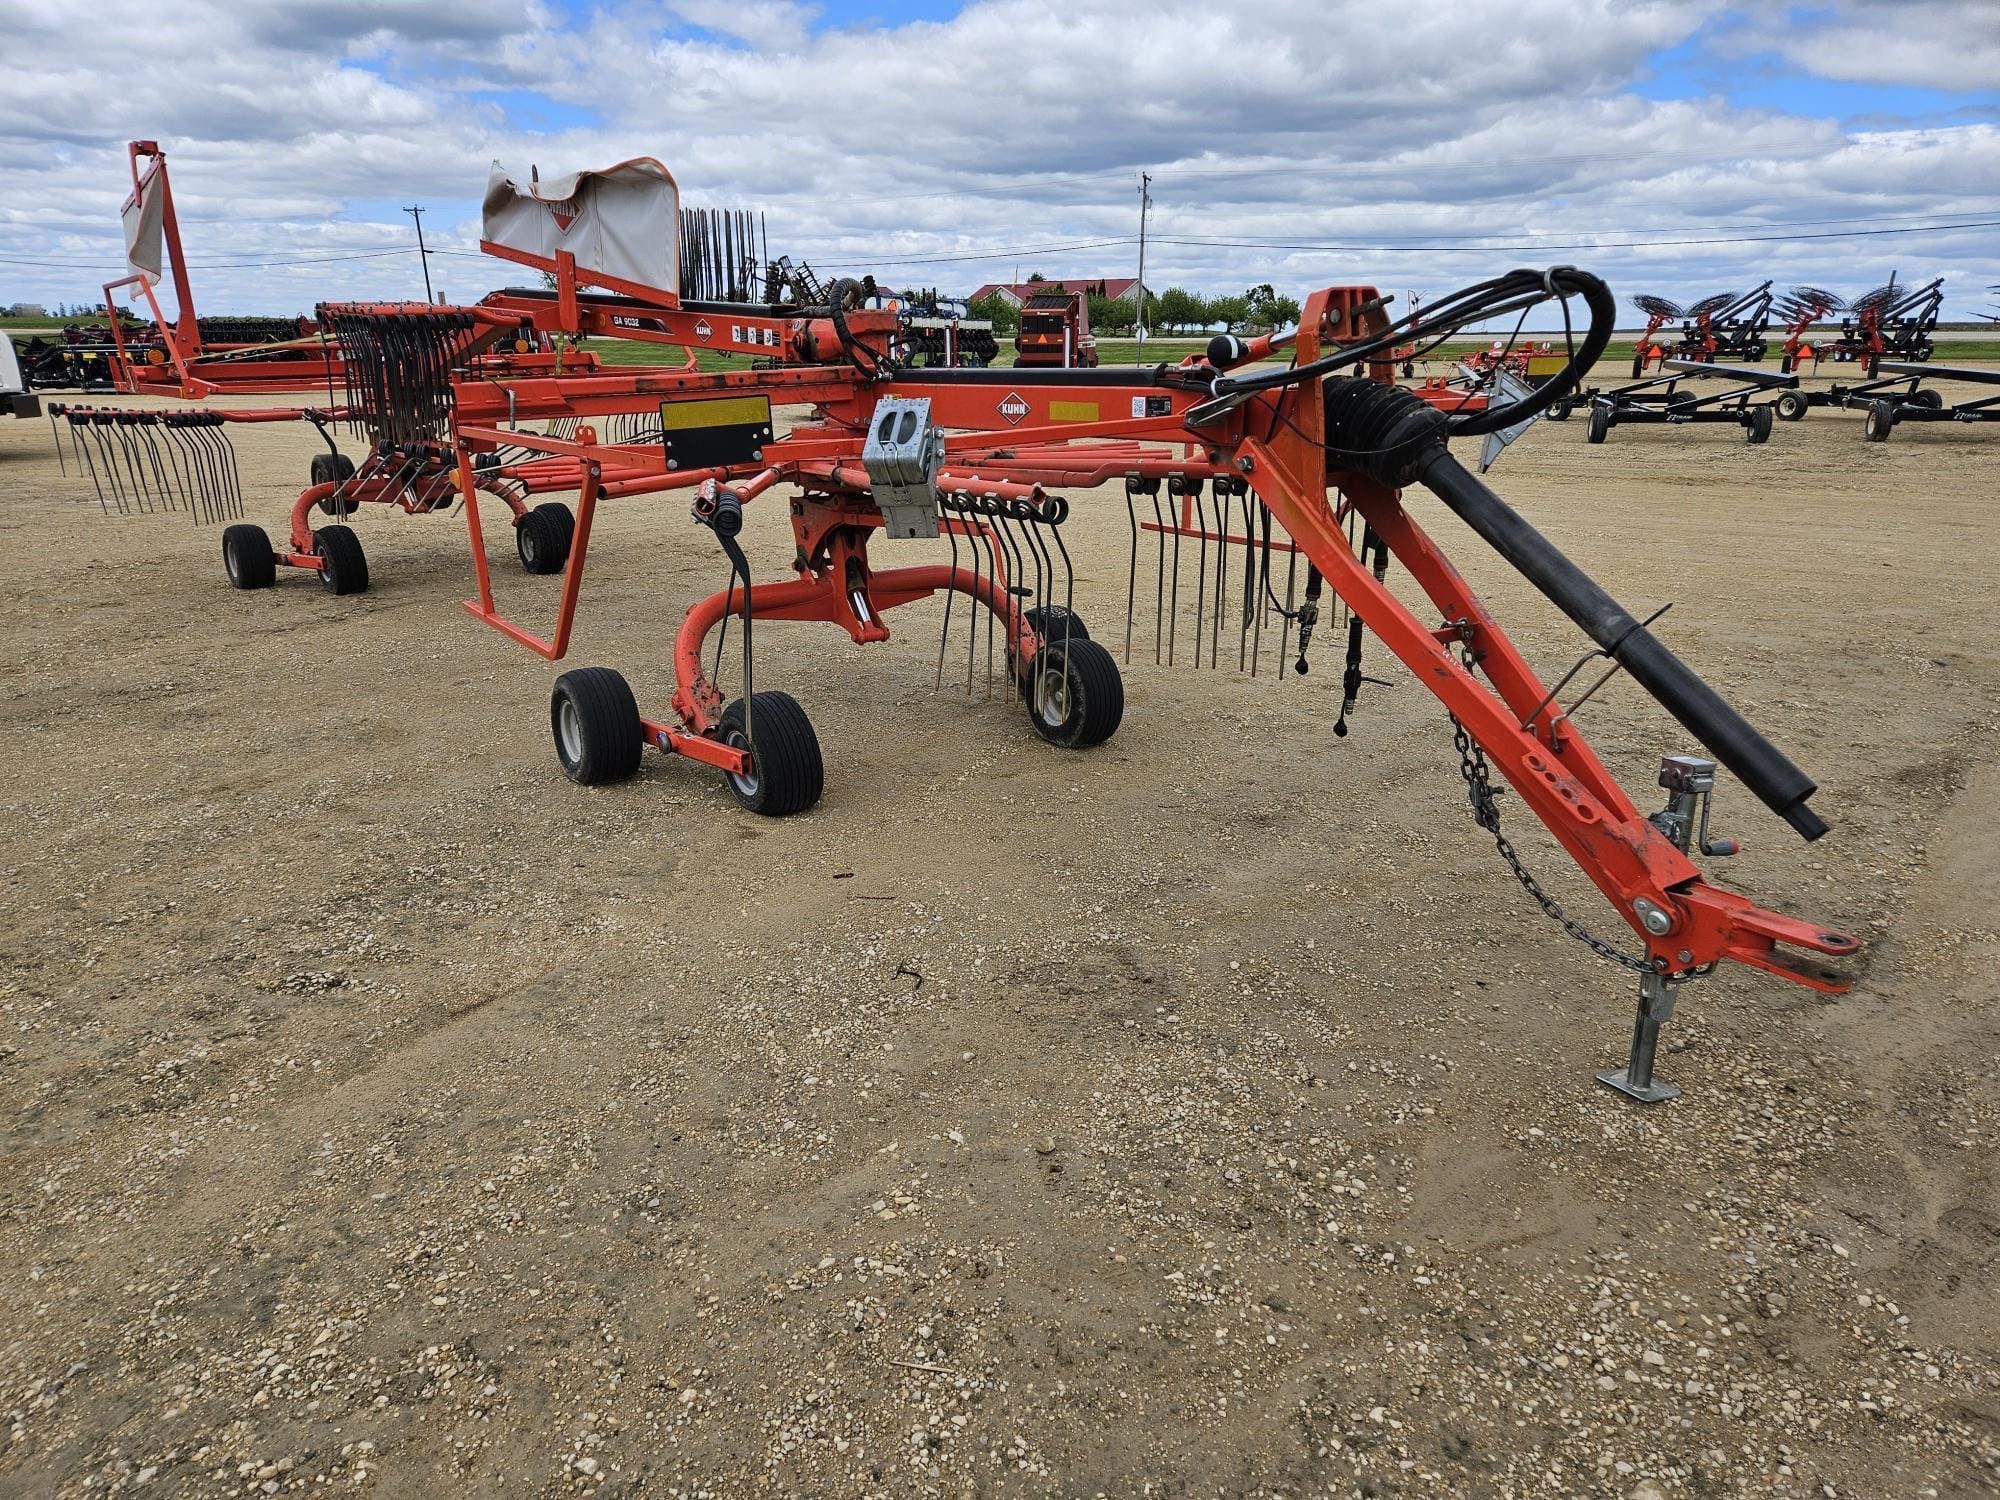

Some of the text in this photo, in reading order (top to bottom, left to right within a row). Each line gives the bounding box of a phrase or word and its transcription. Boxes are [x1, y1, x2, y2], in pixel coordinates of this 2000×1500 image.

[613, 316, 640, 327] GA 9032
[696, 327, 711, 336] KUHN
[1002, 403, 1026, 415] KUHN
